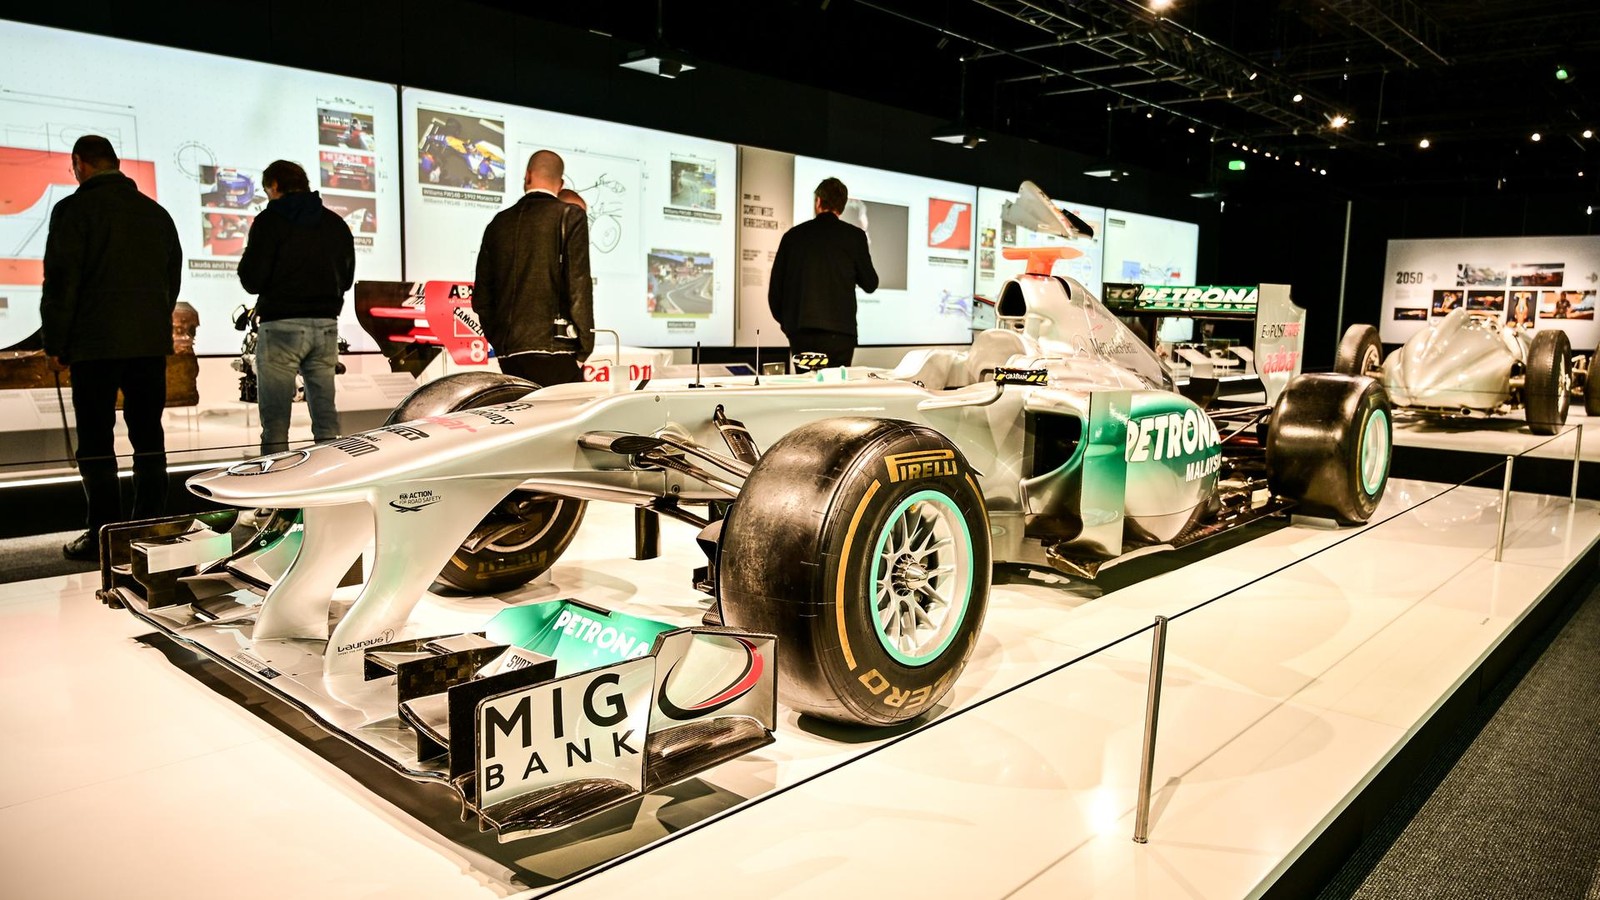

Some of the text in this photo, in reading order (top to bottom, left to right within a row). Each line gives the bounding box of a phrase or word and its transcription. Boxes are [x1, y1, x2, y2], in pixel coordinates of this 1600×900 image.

[190, 261, 211, 269] Lauda
[212, 261, 224, 269] and
[191, 271, 211, 279] Lauda
[1396, 271, 1423, 285] 2050
[453, 306, 484, 336] CAMOZZI
[470, 339, 485, 363] 8
[584, 364, 651, 382] Caon
[884, 449, 958, 483] PIRELLI
[409, 490, 432, 499] ACTION
[422, 495, 442, 503] SAFETY
[337, 636, 384, 653] Laureus
[485, 673, 628, 760] MIG
[485, 729, 640, 792] BANK
